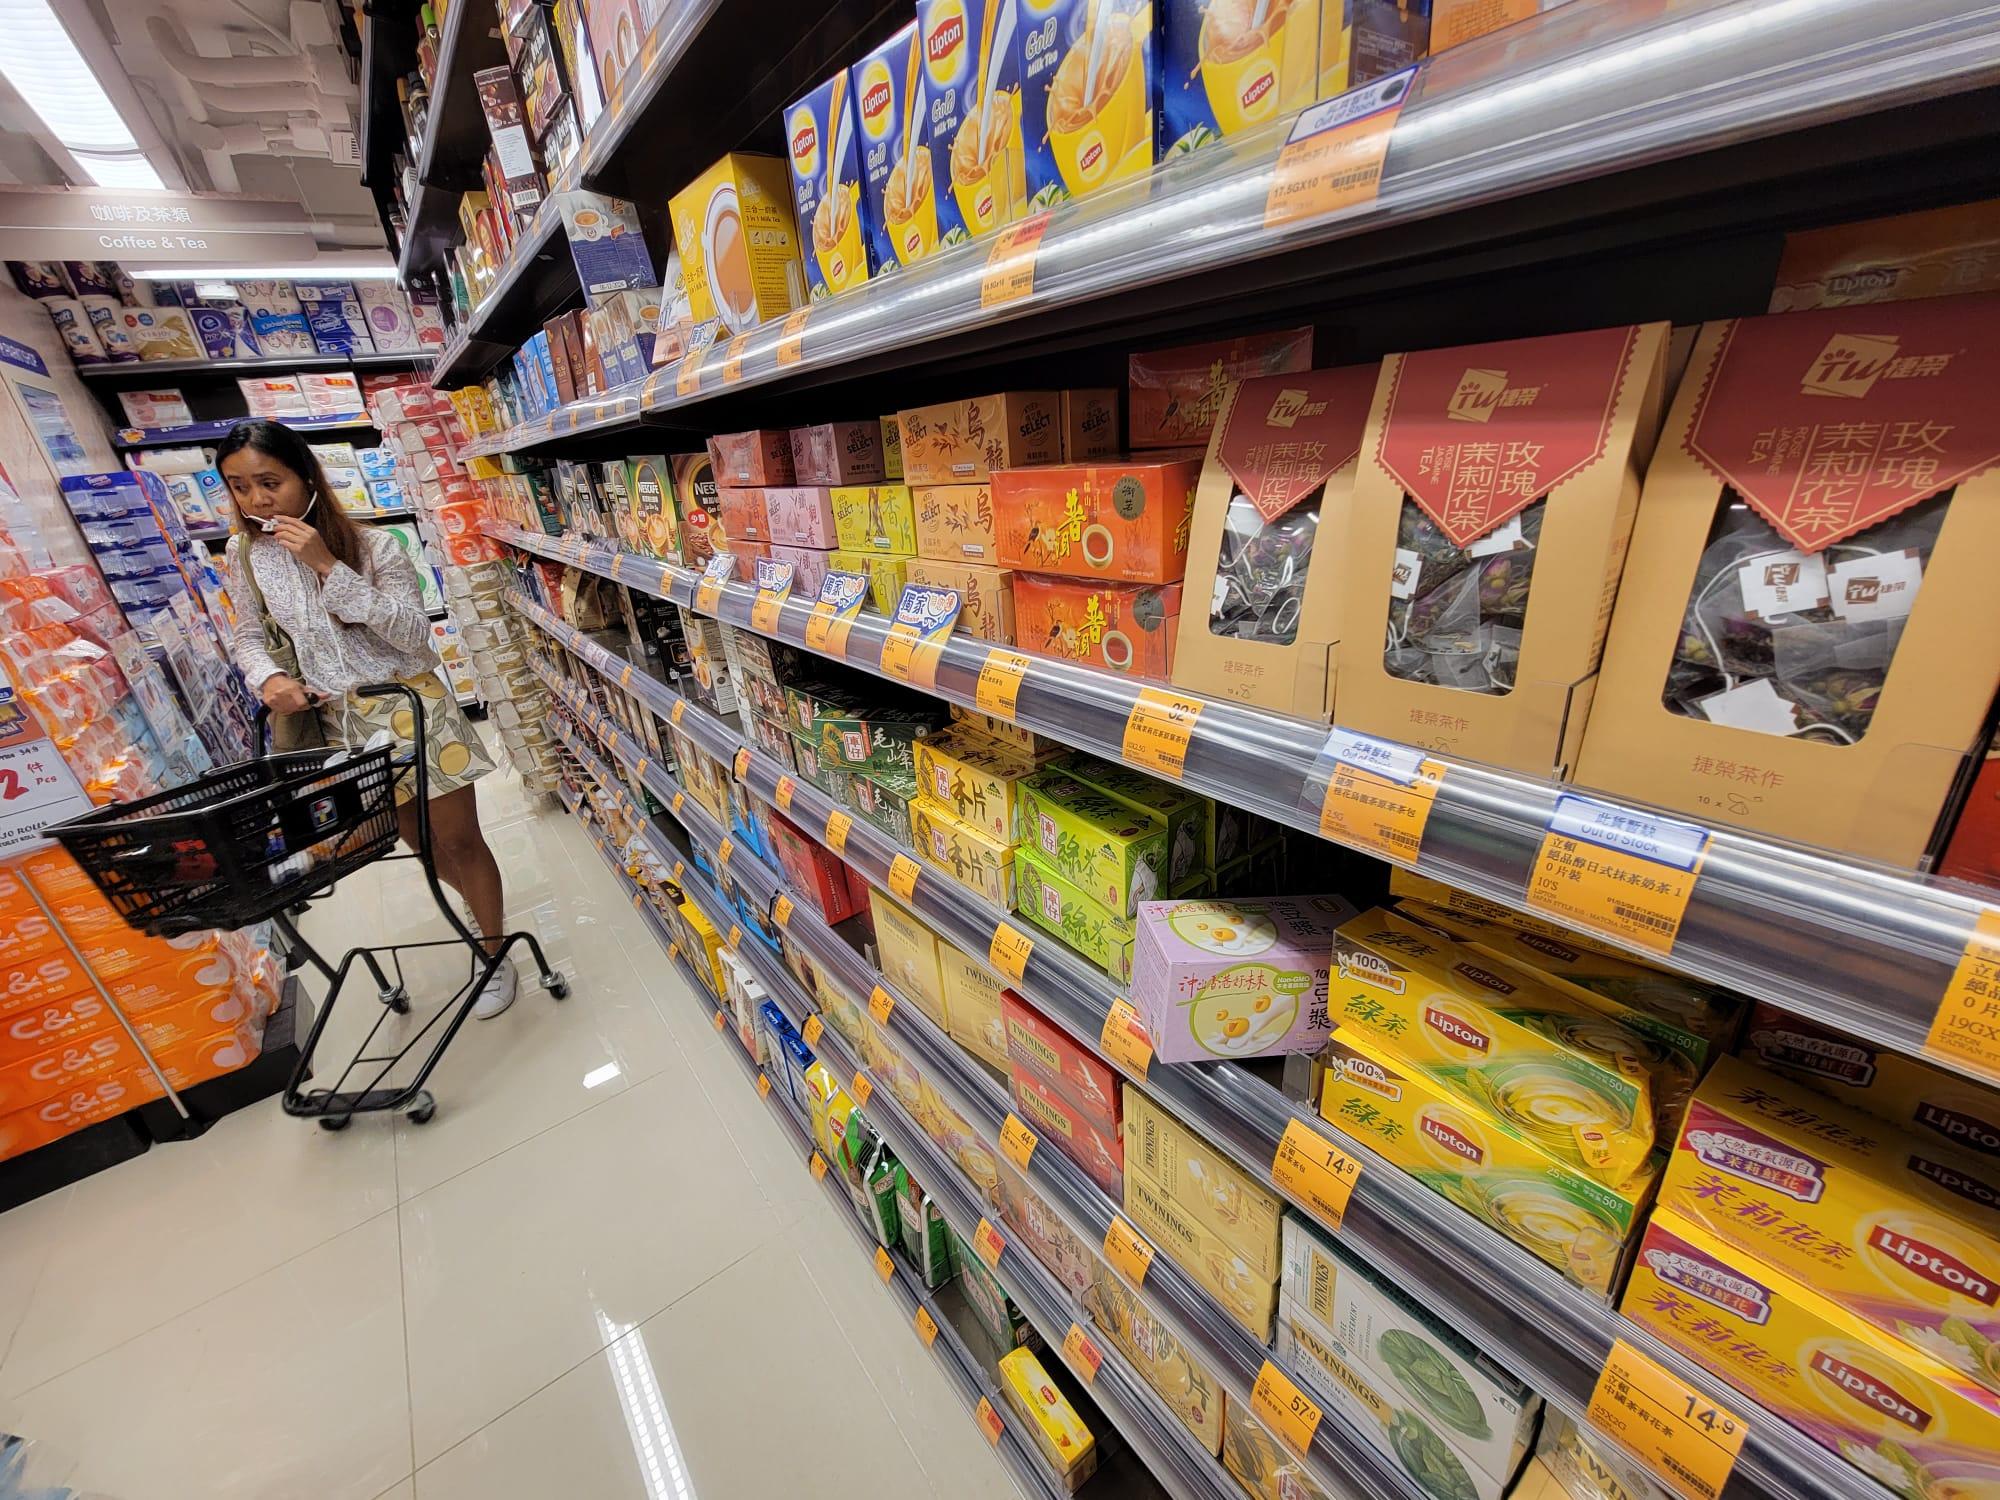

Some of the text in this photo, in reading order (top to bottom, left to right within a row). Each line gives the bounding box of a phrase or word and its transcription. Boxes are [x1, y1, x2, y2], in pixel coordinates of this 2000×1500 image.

[930, 22, 962, 59] Lipton
[1025, 17, 1057, 60] Gold
[1027, 59, 1046, 79] Milk
[864, 84, 889, 112] Lipton
[932, 89, 955, 122] Gold
[1243, 76, 1273, 107] Lipton
[793, 129, 815, 151] Lipton
[934, 122, 947, 138] Milk
[867, 143, 886, 169] Gold
[1082, 144, 1103, 170] Lipton
[798, 180, 813, 203] Gold
[870, 170, 880, 182] Milk
[90, 204, 192, 223] 咖啡及茶類
[99, 235, 207, 249] Coffee & Tea
[1882, 354, 1953, 379] 捷榮
[1498, 386, 1542, 408] 捷榮
[905, 426, 927, 448] SELECT
[1020, 415, 1051, 438] SELECT
[1081, 411, 1111, 434] SELECT
[847, 438, 874, 454] SELECT
[1295, 439, 1328, 483] 玫瑰
[1418, 448, 1432, 476] TEA
[1749, 431, 1776, 464] TEA
[1872, 420, 1955, 490] 玫瑰
[1262, 443, 1299, 510] 茉莉花茶
[1498, 440, 1545, 497] 玫瑰
[1791, 421, 1882, 533] 茉莉花茶
[1448, 442, 1501, 531] 茉莉花茶
[837, 504, 855, 520] SELECT
[920, 503, 941, 522] SELECT
[1410, 708, 1470, 732] 捷榮茶作
[1692, 755, 1785, 789] 捷榮茶作
[950, 767, 987, 823] 香片
[1697, 795, 1711, 805] 10
[1041, 817, 1058, 855] 車仔
[1552, 837, 1577, 853] 立頓
[1581, 823, 1603, 839] Out
[1620, 834, 1659, 854] Stock
[1537, 876, 1559, 891] 10'S
[1546, 850, 1673, 895] 絕品醇日式抹茶奶茶
[1555, 867, 1582, 883] 片裝
[1355, 953, 1388, 974] 100%
[1523, 934, 1575, 961] Lipton
[1277, 975, 1310, 985] Non-GMO
[1460, 963, 1509, 992] Lipton
[10, 996, 102, 1040] C&S
[1344, 993, 1410, 1036] 綠茶
[1429, 1009, 1484, 1049] Lipton
[1011, 1022, 1056, 1065] TWININGS
[1938, 1034, 1984, 1055] TAIWAN
[1941, 1028, 1981, 1047] LIPTON
[30, 1036, 120, 1081] C&S
[1350, 1058, 1385, 1083] 100%
[1552, 1049, 1622, 1092] 25 50
[40, 1080, 126, 1122] C&S
[1024, 1086, 1067, 1130] TWININGS
[1340, 1097, 1406, 1140] 綠茶
[1724, 1087, 1880, 1150] 茉莉花茶
[1145, 1118, 1156, 1169] TWININGS
[1424, 1119, 1478, 1160] Lipton
[1925, 1107, 2000, 1149] Lipto
[1325, 1150, 1355, 1175] 14.9
[1718, 1135, 1811, 1176] 天然香氣源自
[1726, 1154, 1800, 1191] 茉莉鮮花
[1547, 1166, 1617, 1210] 25 50
[1918, 1158, 2000, 1203] Lipto
[1136, 1184, 1193, 1244] TWININGS
[1676, 1171, 1857, 1261] 茉莉花茶
[1709, 1206, 1816, 1259] JASMINE TEABAG
[1671, 1255, 1759, 1299] 天然香氣源自
[1878, 1230, 1989, 1302] Lipton
[1314, 1261, 1330, 1317] TWININGS
[1680, 1273, 1749, 1311] 茉莉鮮花
[1636, 1286, 1800, 1378] 茉莉花茶
[1298, 1327, 1381, 1410] TWININGS
[1605, 1373, 1631, 1395] 立頓
[1290, 1394, 1317, 1422] 57.0
[1820, 1356, 1919, 1426] Lipton
[1683, 1394, 1737, 1436] 14.9
